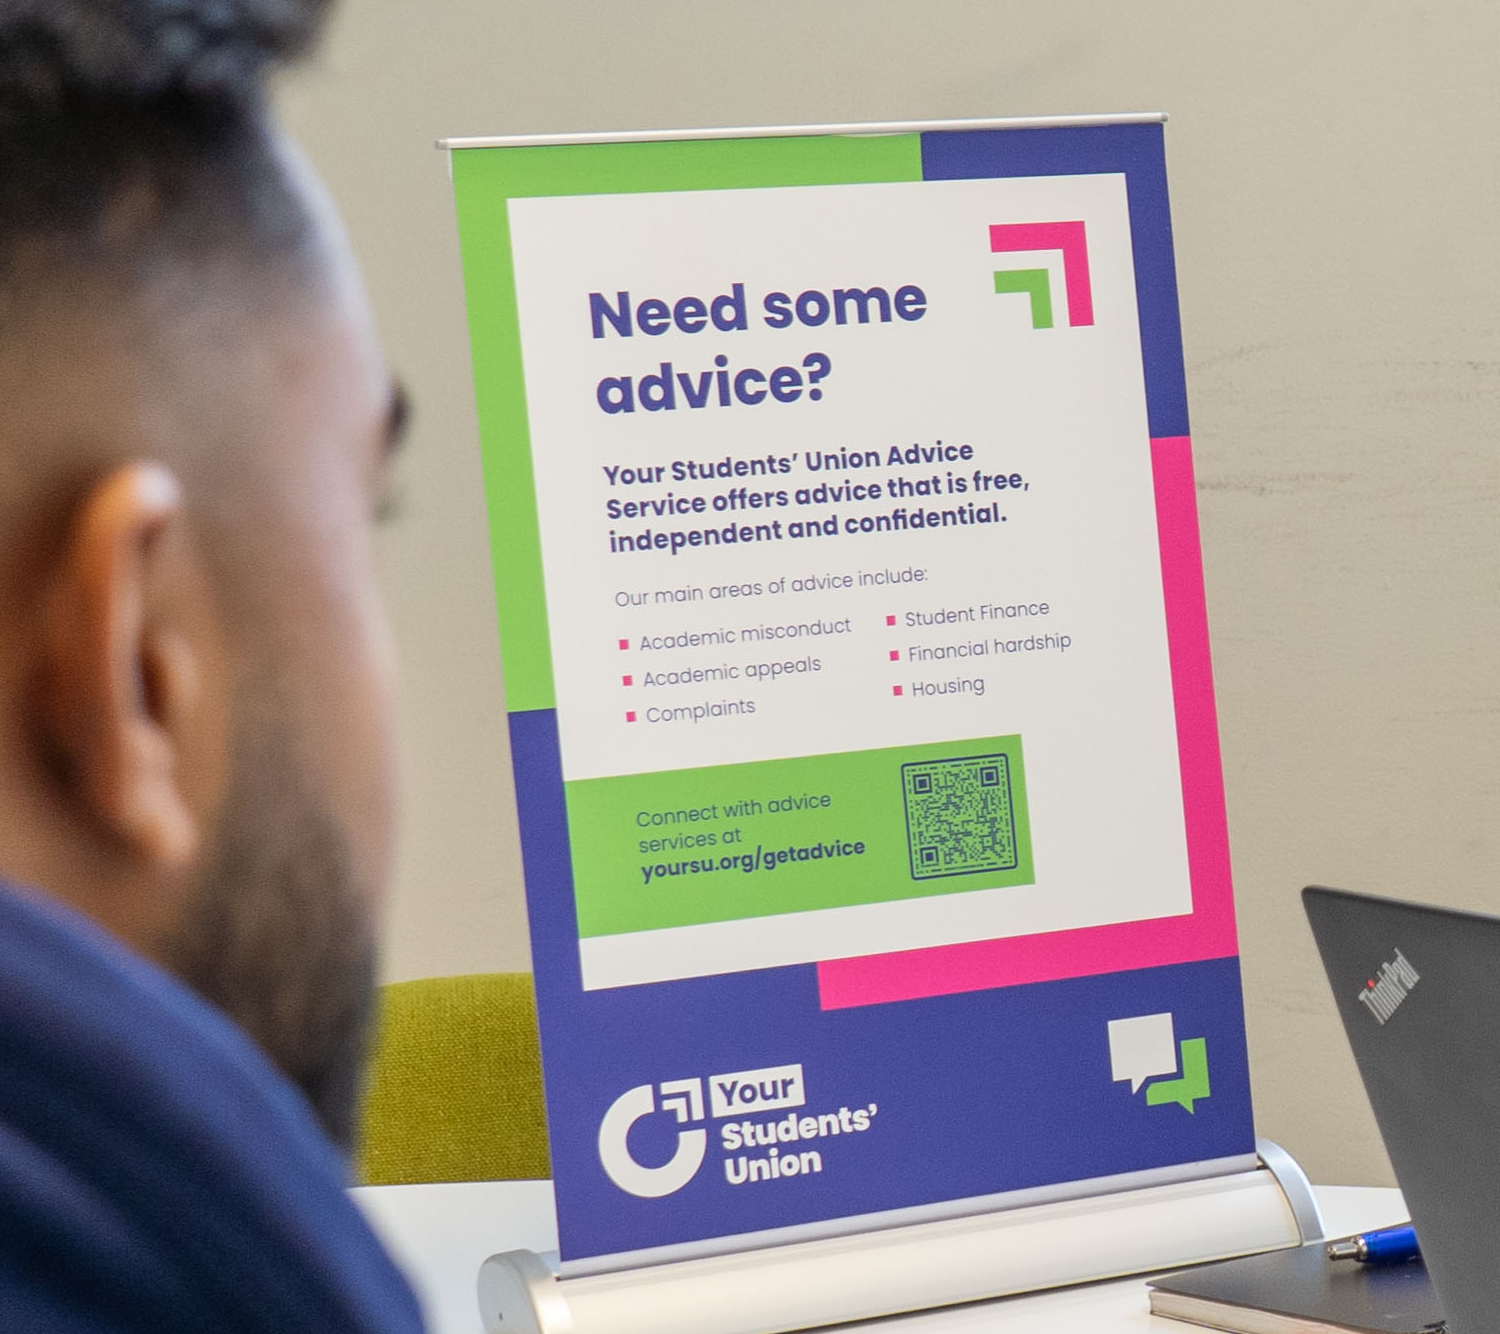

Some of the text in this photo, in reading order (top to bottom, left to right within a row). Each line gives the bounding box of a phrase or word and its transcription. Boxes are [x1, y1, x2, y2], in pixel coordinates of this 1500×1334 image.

[588, 282, 928, 340] Need some
[596, 351, 832, 415] advice?
[602, 465, 666, 486] Your
[805, 446, 881, 472] Union
[886, 439, 974, 467] Advice
[606, 469, 1029, 520] Service offers advice that is free,
[609, 501, 1008, 556] independent and confidential.
[614, 566, 928, 608] Our main areas of advice include:
[905, 602, 1050, 628] Student Finance
[639, 618, 852, 651] Academic misconduct
[908, 633, 1072, 662] Financial hardship
[643, 655, 822, 687] Academic appeals
[911, 676, 986, 697] Housing
[645, 699, 756, 724] Complaints
[635, 792, 832, 828] Connect with advice
[638, 827, 742, 854] services at
[639, 838, 866, 885] yoursu.org/getadvice
[1357, 947, 1421, 1026] ThinkPad
[717, 1077, 795, 1107] Your
[724, 1147, 823, 1185] Union
